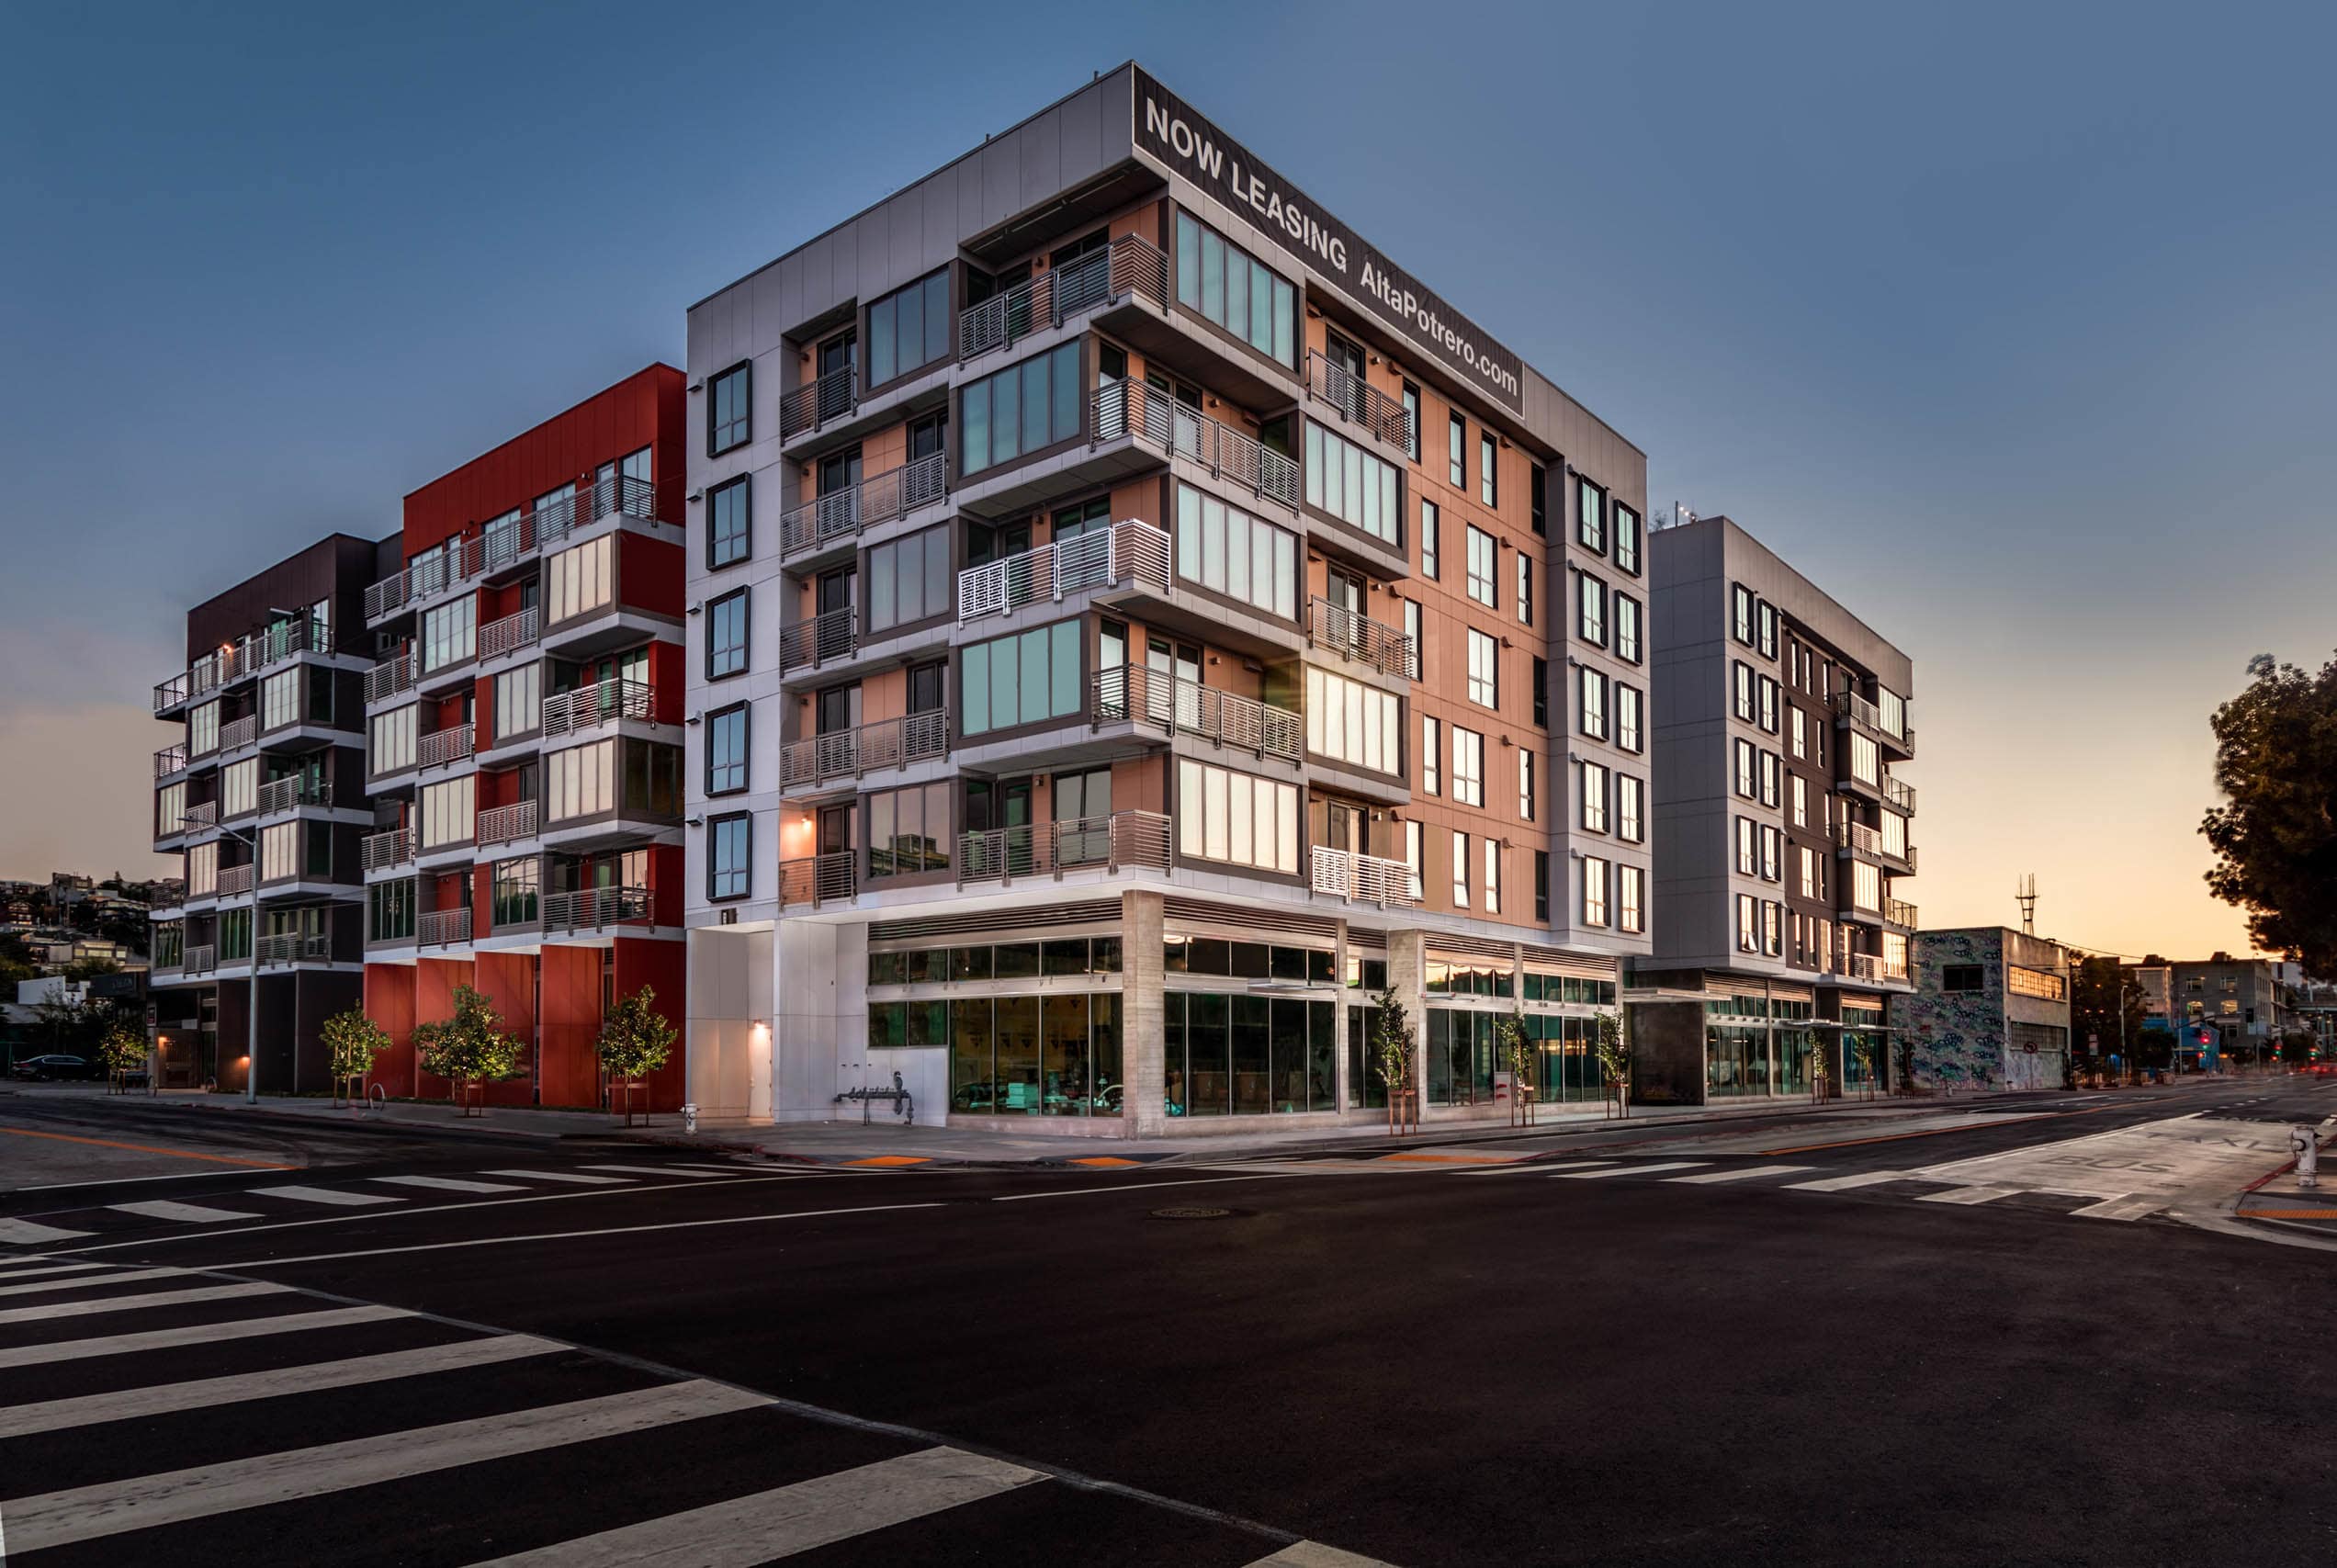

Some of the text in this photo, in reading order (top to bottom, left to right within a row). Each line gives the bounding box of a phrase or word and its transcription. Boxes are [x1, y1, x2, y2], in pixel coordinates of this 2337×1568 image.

[1146, 96, 1518, 397] NOW LEASING AltaPotrero.com
[2147, 1132, 2261, 1149] TAXI
[2039, 1156, 2176, 1173] BUS
